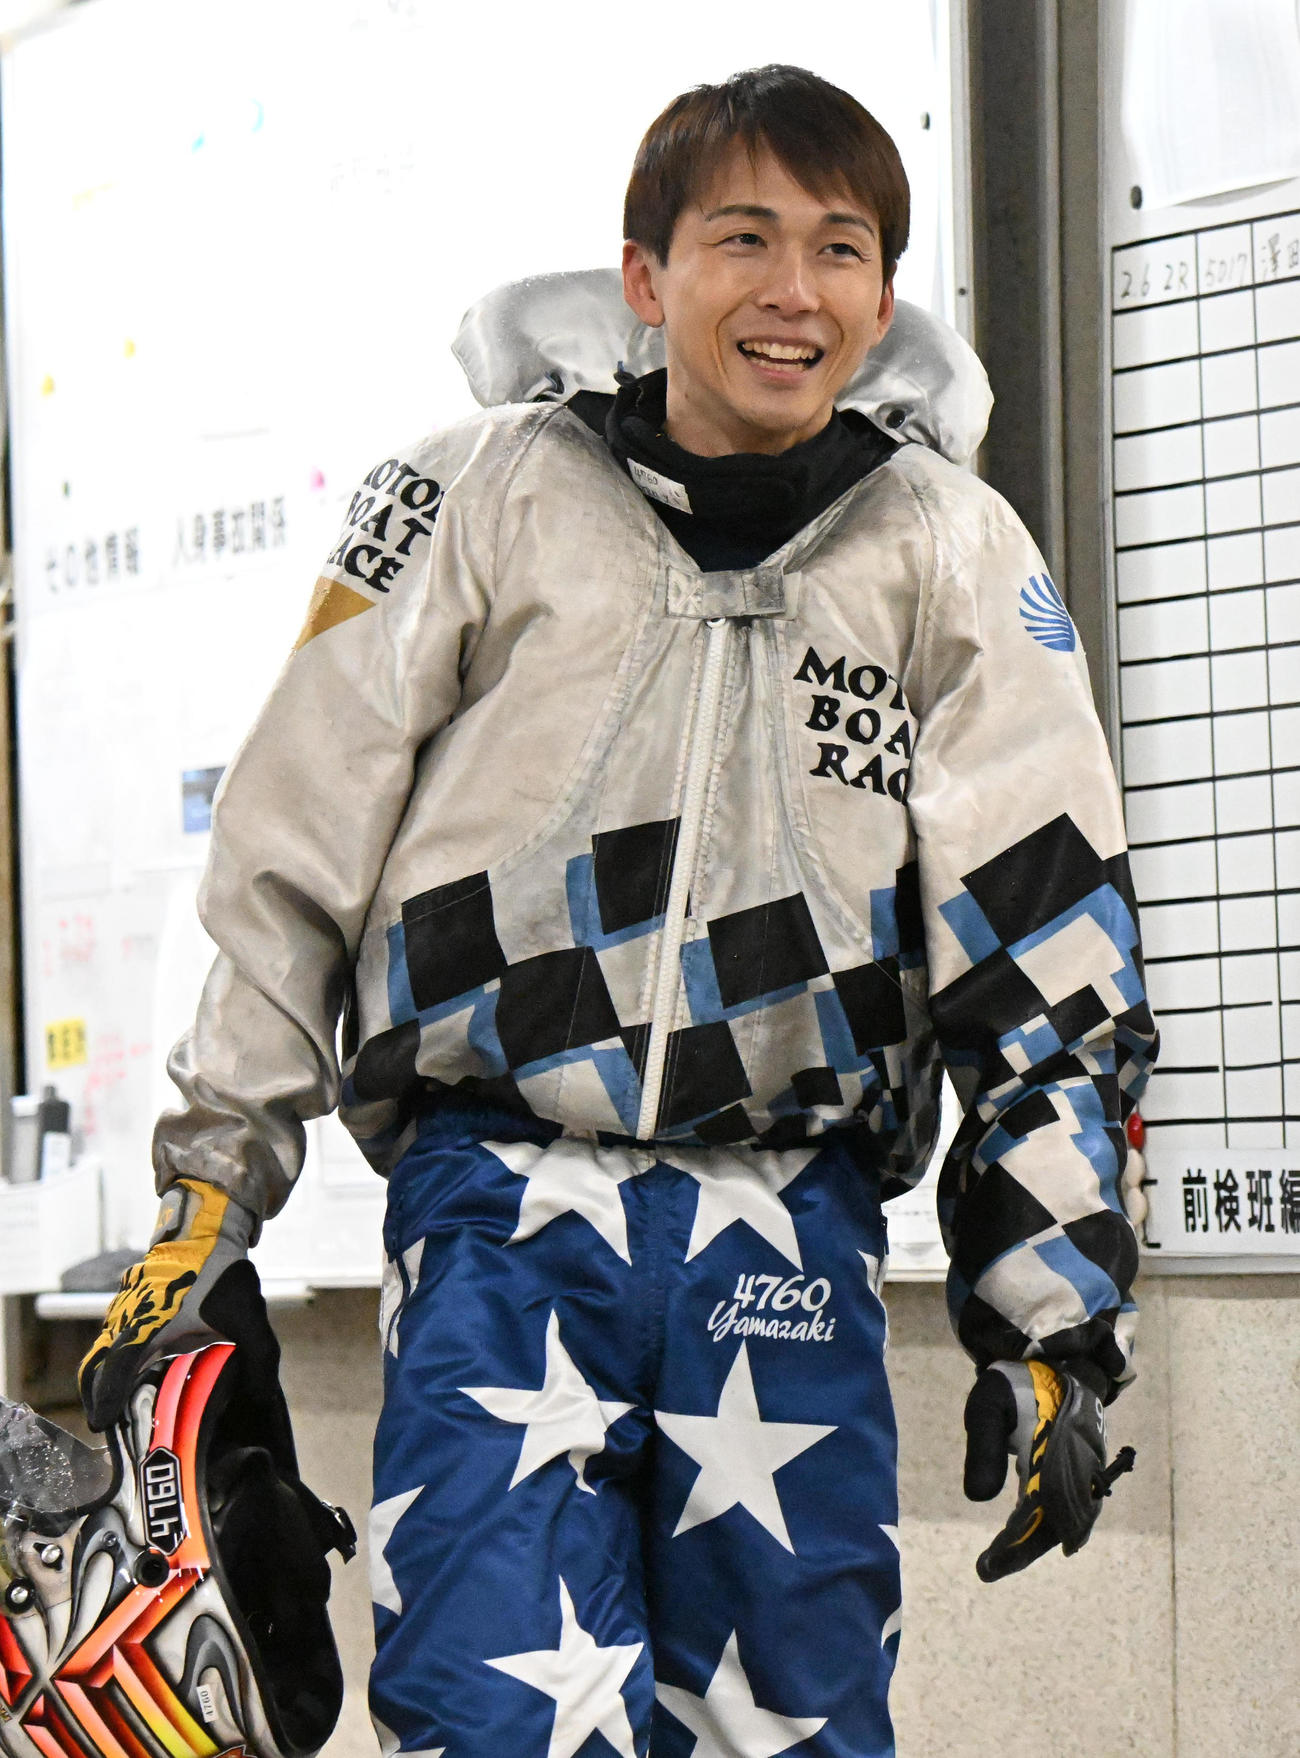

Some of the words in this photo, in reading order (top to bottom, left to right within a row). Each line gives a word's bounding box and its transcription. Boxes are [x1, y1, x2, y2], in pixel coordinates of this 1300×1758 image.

[326, 532, 405, 594] ACE
[1182, 1168, 1300, 1234] 前検班編
[706, 1300, 837, 1343] Yamazaki
[733, 1273, 832, 1312] 4760
[145, 1462, 180, 1538] 4760
